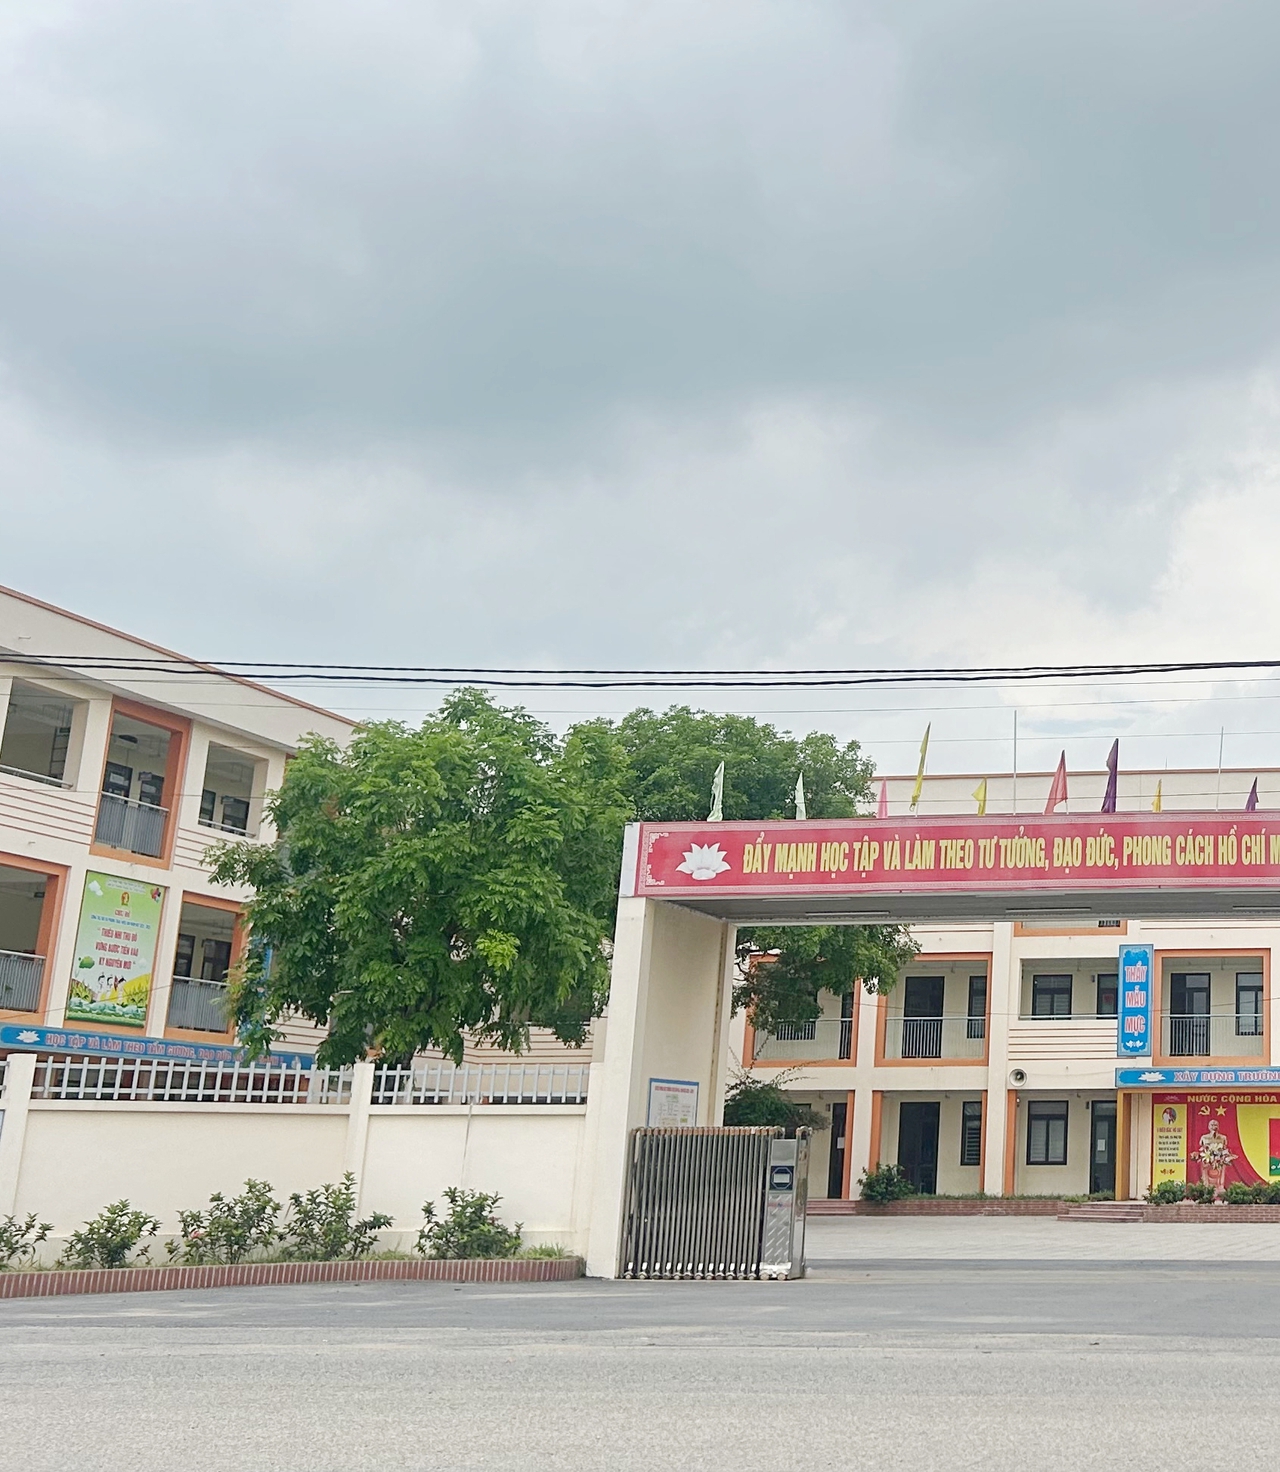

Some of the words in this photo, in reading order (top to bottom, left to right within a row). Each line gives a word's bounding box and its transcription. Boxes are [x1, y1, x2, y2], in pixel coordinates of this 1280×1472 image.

[742, 831, 772, 873] ĐẨY
[774, 842, 817, 879] MẠNH
[820, 841, 849, 878] HỌC
[853, 835, 880, 878] TẬP
[883, 833, 900, 870] VÀ
[904, 833, 936, 870] LÀM
[939, 838, 974, 870] THEO
[978, 835, 998, 869] TƯ
[999, 826, 1049, 871] TƯỞNG,
[1053, 836, 1082, 874] ĐẠO
[1085, 828, 1119, 870] ĐỨC,
[1123, 835, 1172, 866] PHONG
[1175, 828, 1214, 866] CÁCH
[1218, 824, 1237, 865] HỒ
[1241, 828, 1266, 865] CHÍ
[1124, 1014, 1146, 1036] MỰC
[45, 1033, 66, 1048] HỌC
[67, 1034, 86, 1049] TẬP
[88, 1036, 100, 1050] VÀ
[101, 1037, 122, 1051] LÀM
[123, 1041, 145, 1054] THEO
[1174, 1070, 1199, 1082] XÂY
[1201, 1071, 1235, 1083] DỰNG
[1187, 1093, 1217, 1103] NƯỚC
[1221, 1094, 1251, 1104] CỘNG
[1254, 1093, 1278, 1103] HÒA
